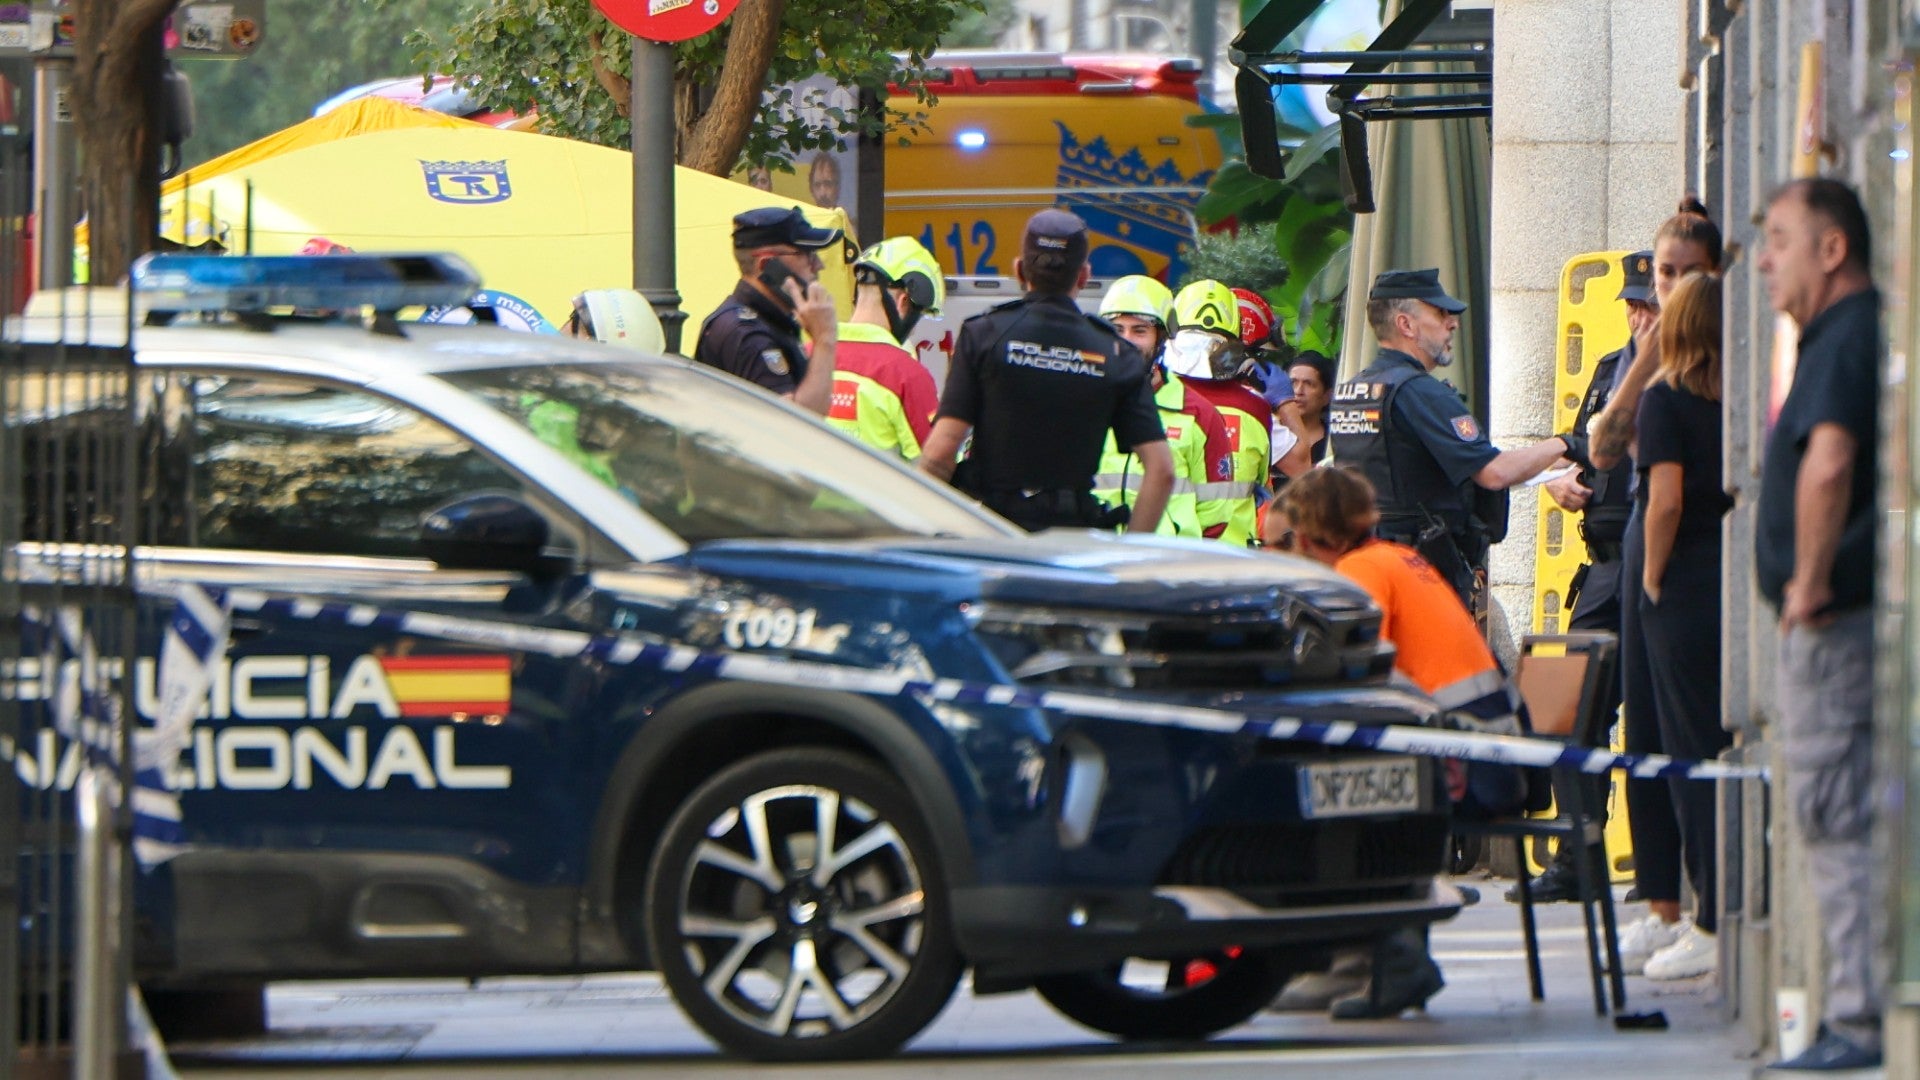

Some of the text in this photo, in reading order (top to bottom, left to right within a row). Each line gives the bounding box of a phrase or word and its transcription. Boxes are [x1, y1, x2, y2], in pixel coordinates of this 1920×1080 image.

[919, 220, 999, 276] 112
[1006, 340, 1085, 363] POLICIA
[1006, 352, 1105, 378] NACIONAL
